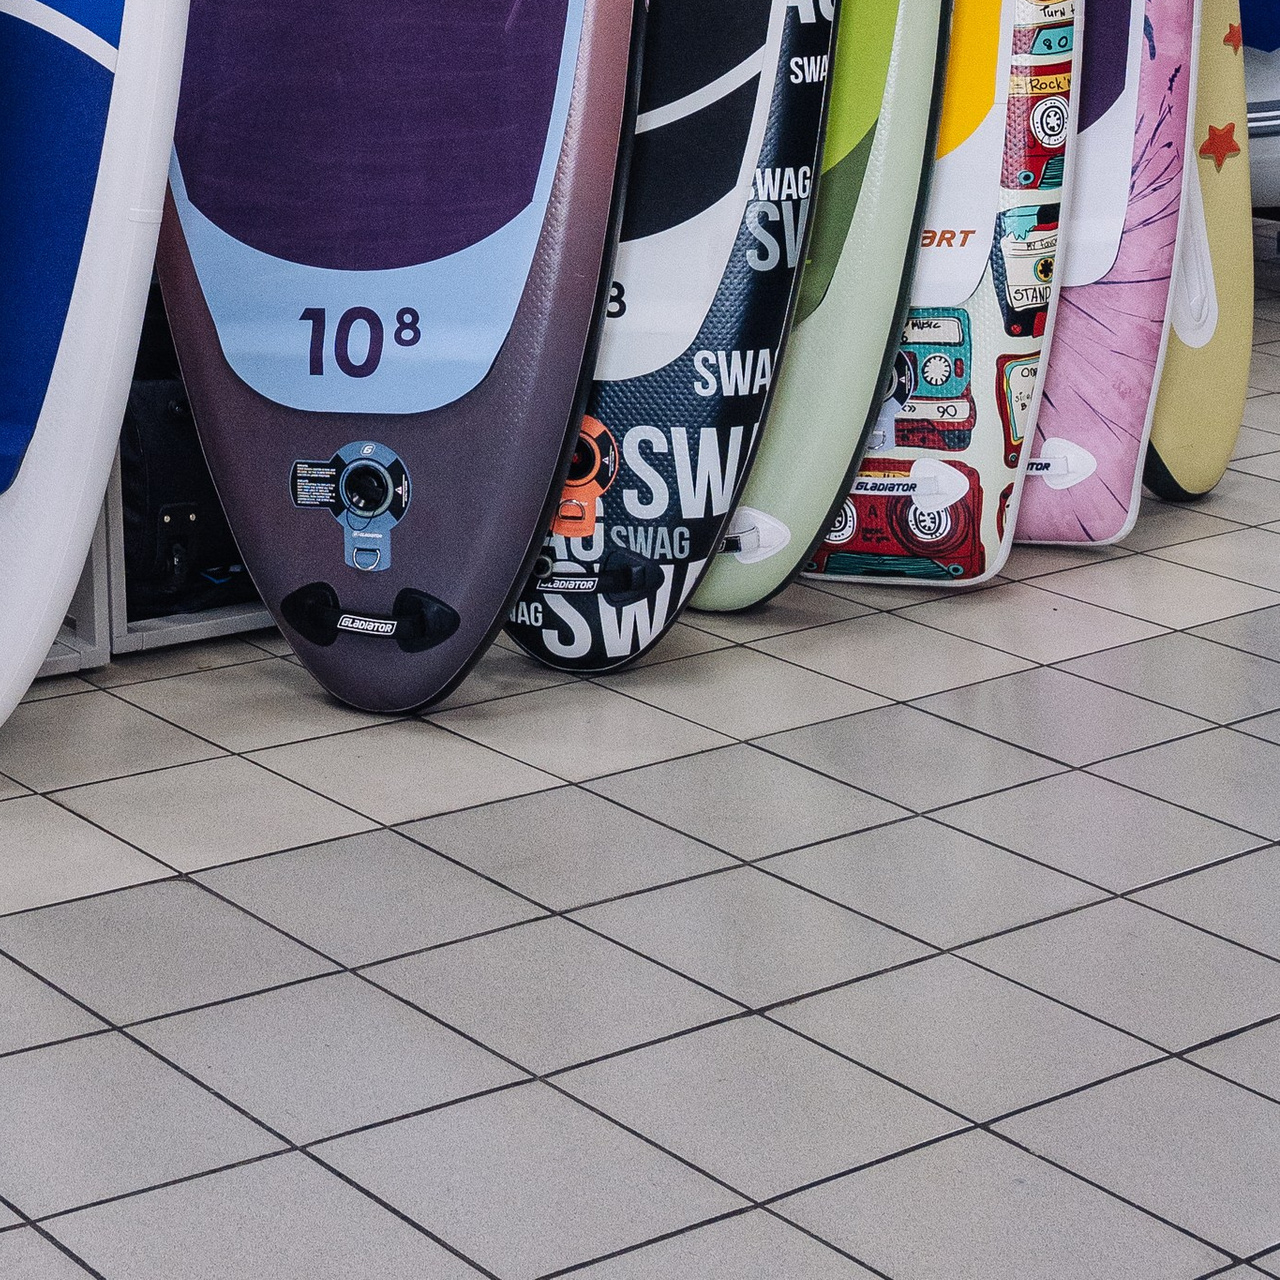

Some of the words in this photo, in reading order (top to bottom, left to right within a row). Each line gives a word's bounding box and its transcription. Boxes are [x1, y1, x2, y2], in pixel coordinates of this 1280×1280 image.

[752, 165, 811, 201] WAG
[936, 404, 958, 418] 90
[855, 481, 918, 493] GLADIATOR
[341, 617, 395, 634] GLADIATOR
